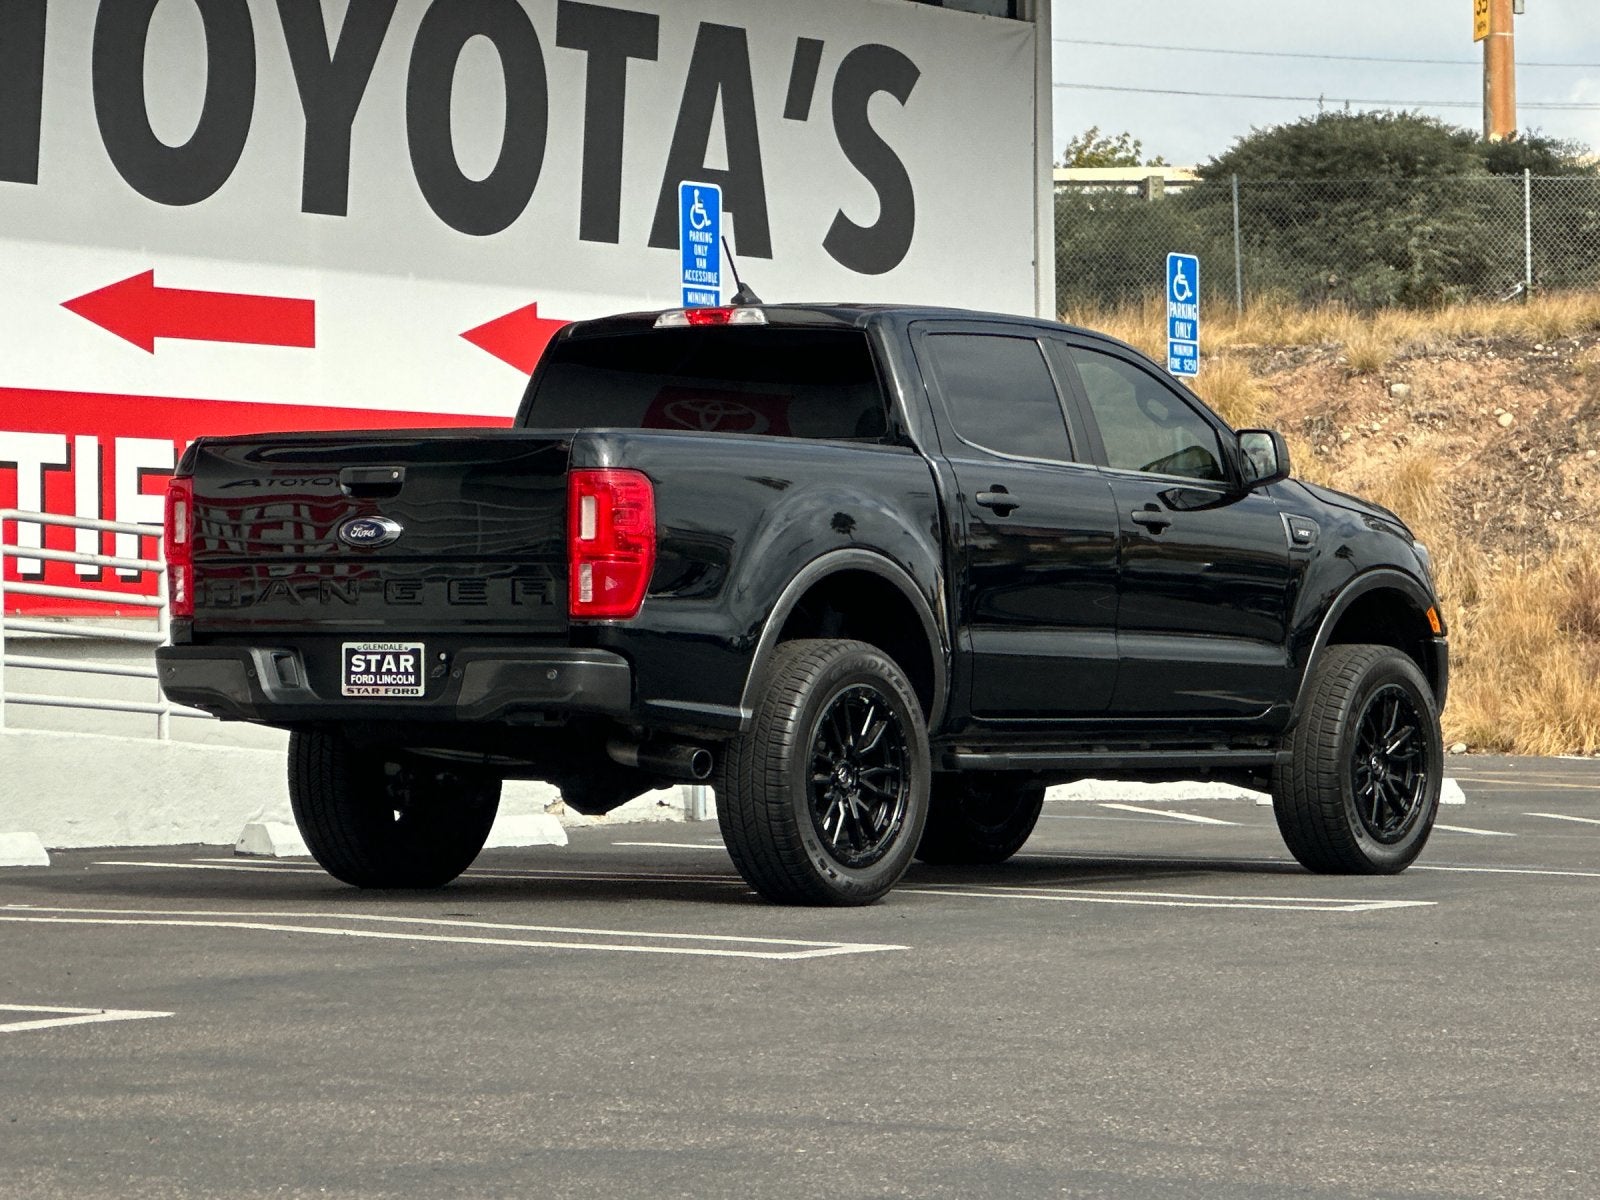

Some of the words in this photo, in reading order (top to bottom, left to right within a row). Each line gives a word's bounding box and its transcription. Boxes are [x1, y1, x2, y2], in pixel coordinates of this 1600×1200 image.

[689, 230, 713, 244] PARKING
[693, 244, 708, 257] ONLY
[695, 257, 707, 269] VAN
[684, 269, 718, 284] ACCESSIBLE
[687, 291, 716, 307] MINIMUM
[1169, 301, 1197, 321] PARKING
[1174, 321, 1192, 339] ONLY
[1173, 343, 1194, 357] MINIMUM
[1170, 357, 1181, 370] FINE
[1183, 358, 1197, 371] $250
[0, 431, 197, 583] TIF
[350, 524, 377, 538] Ford
[204, 577, 554, 607] RANGER
[362, 643, 403, 651] GLENDALE
[350, 654, 415, 673] STAR
[350, 674, 375, 684] FORD
[377, 674, 415, 684] LINCOLN
[346, 687, 381, 695] STAR
[384, 687, 419, 695] FORD
